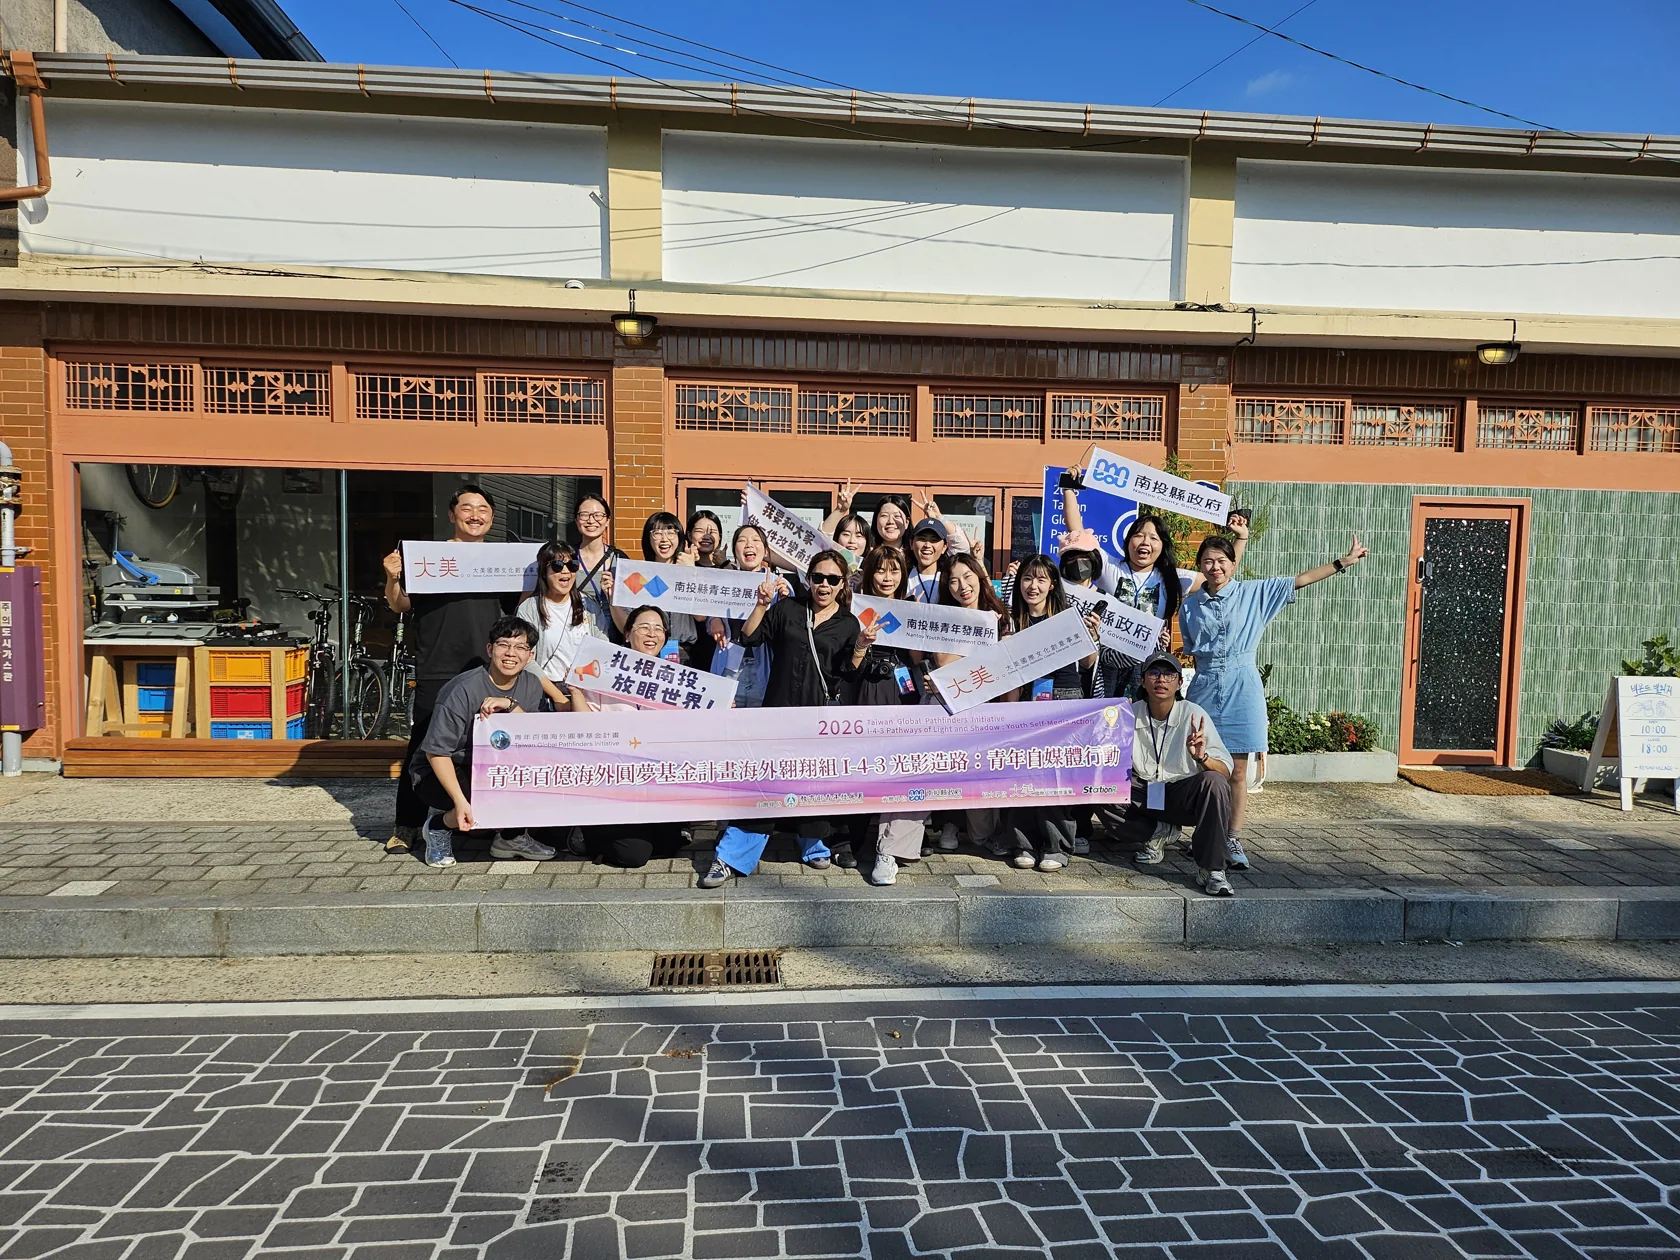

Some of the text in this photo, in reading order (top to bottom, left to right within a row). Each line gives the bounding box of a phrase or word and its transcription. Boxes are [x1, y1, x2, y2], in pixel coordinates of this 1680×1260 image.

[1134, 474, 1223, 512] 南投縣政府
[1132, 488, 1220, 518] Nantou County Government
[762, 502, 817, 546] 我要和大家
[710, 599, 746, 607] Development
[2, 602, 11, 626] 주의
[907, 618, 994, 639] 南投縣青年發展所
[941, 636, 976, 645] Development
[1107, 630, 1147, 651] Government
[2, 628, 13, 682] 도시가스관
[818, 720, 864, 735] 2026
[886, 727, 922, 736] Pathways
[933, 725, 952, 734] Light
[954, 724, 969, 732] and
[970, 722, 1000, 732] Shadow
[1005, 722, 1028, 730] Youth
[925, 716, 968, 725] Pathfinders
[971, 715, 1005, 723] Initiative
[1641, 725, 1666, 734] 10:00
[558, 740, 593, 748] Pathfinders
